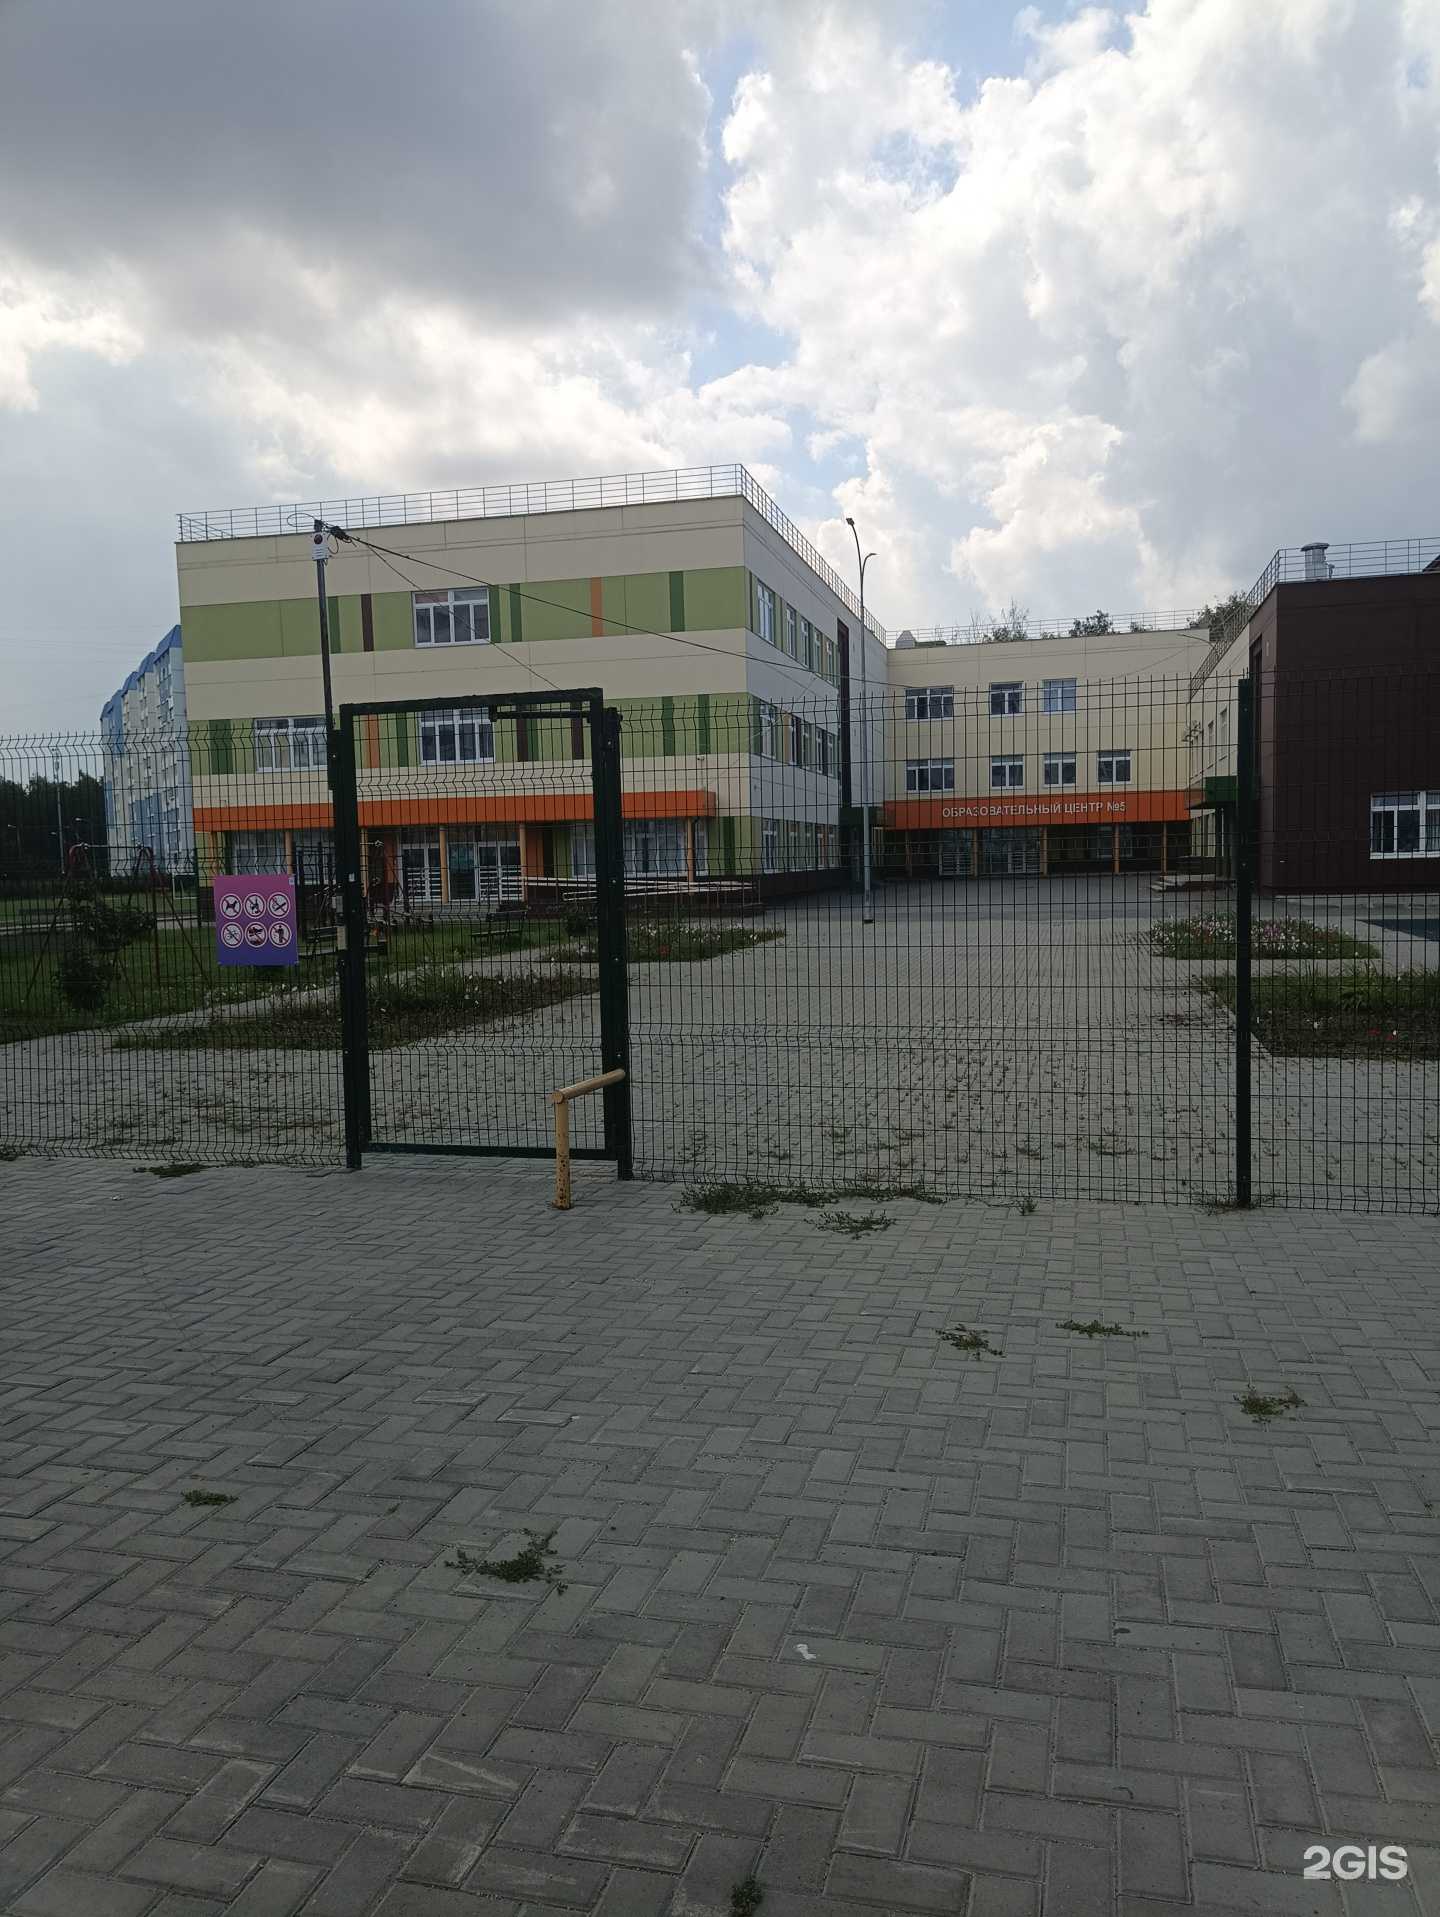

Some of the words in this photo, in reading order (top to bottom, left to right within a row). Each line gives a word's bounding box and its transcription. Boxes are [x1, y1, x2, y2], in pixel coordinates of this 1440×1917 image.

[942, 803, 1061, 817] ОБРАЗОВАТЕЛЬНЫЙ
[1064, 802, 1103, 815] ЦЕНТР
[1107, 801, 1126, 812] №5
